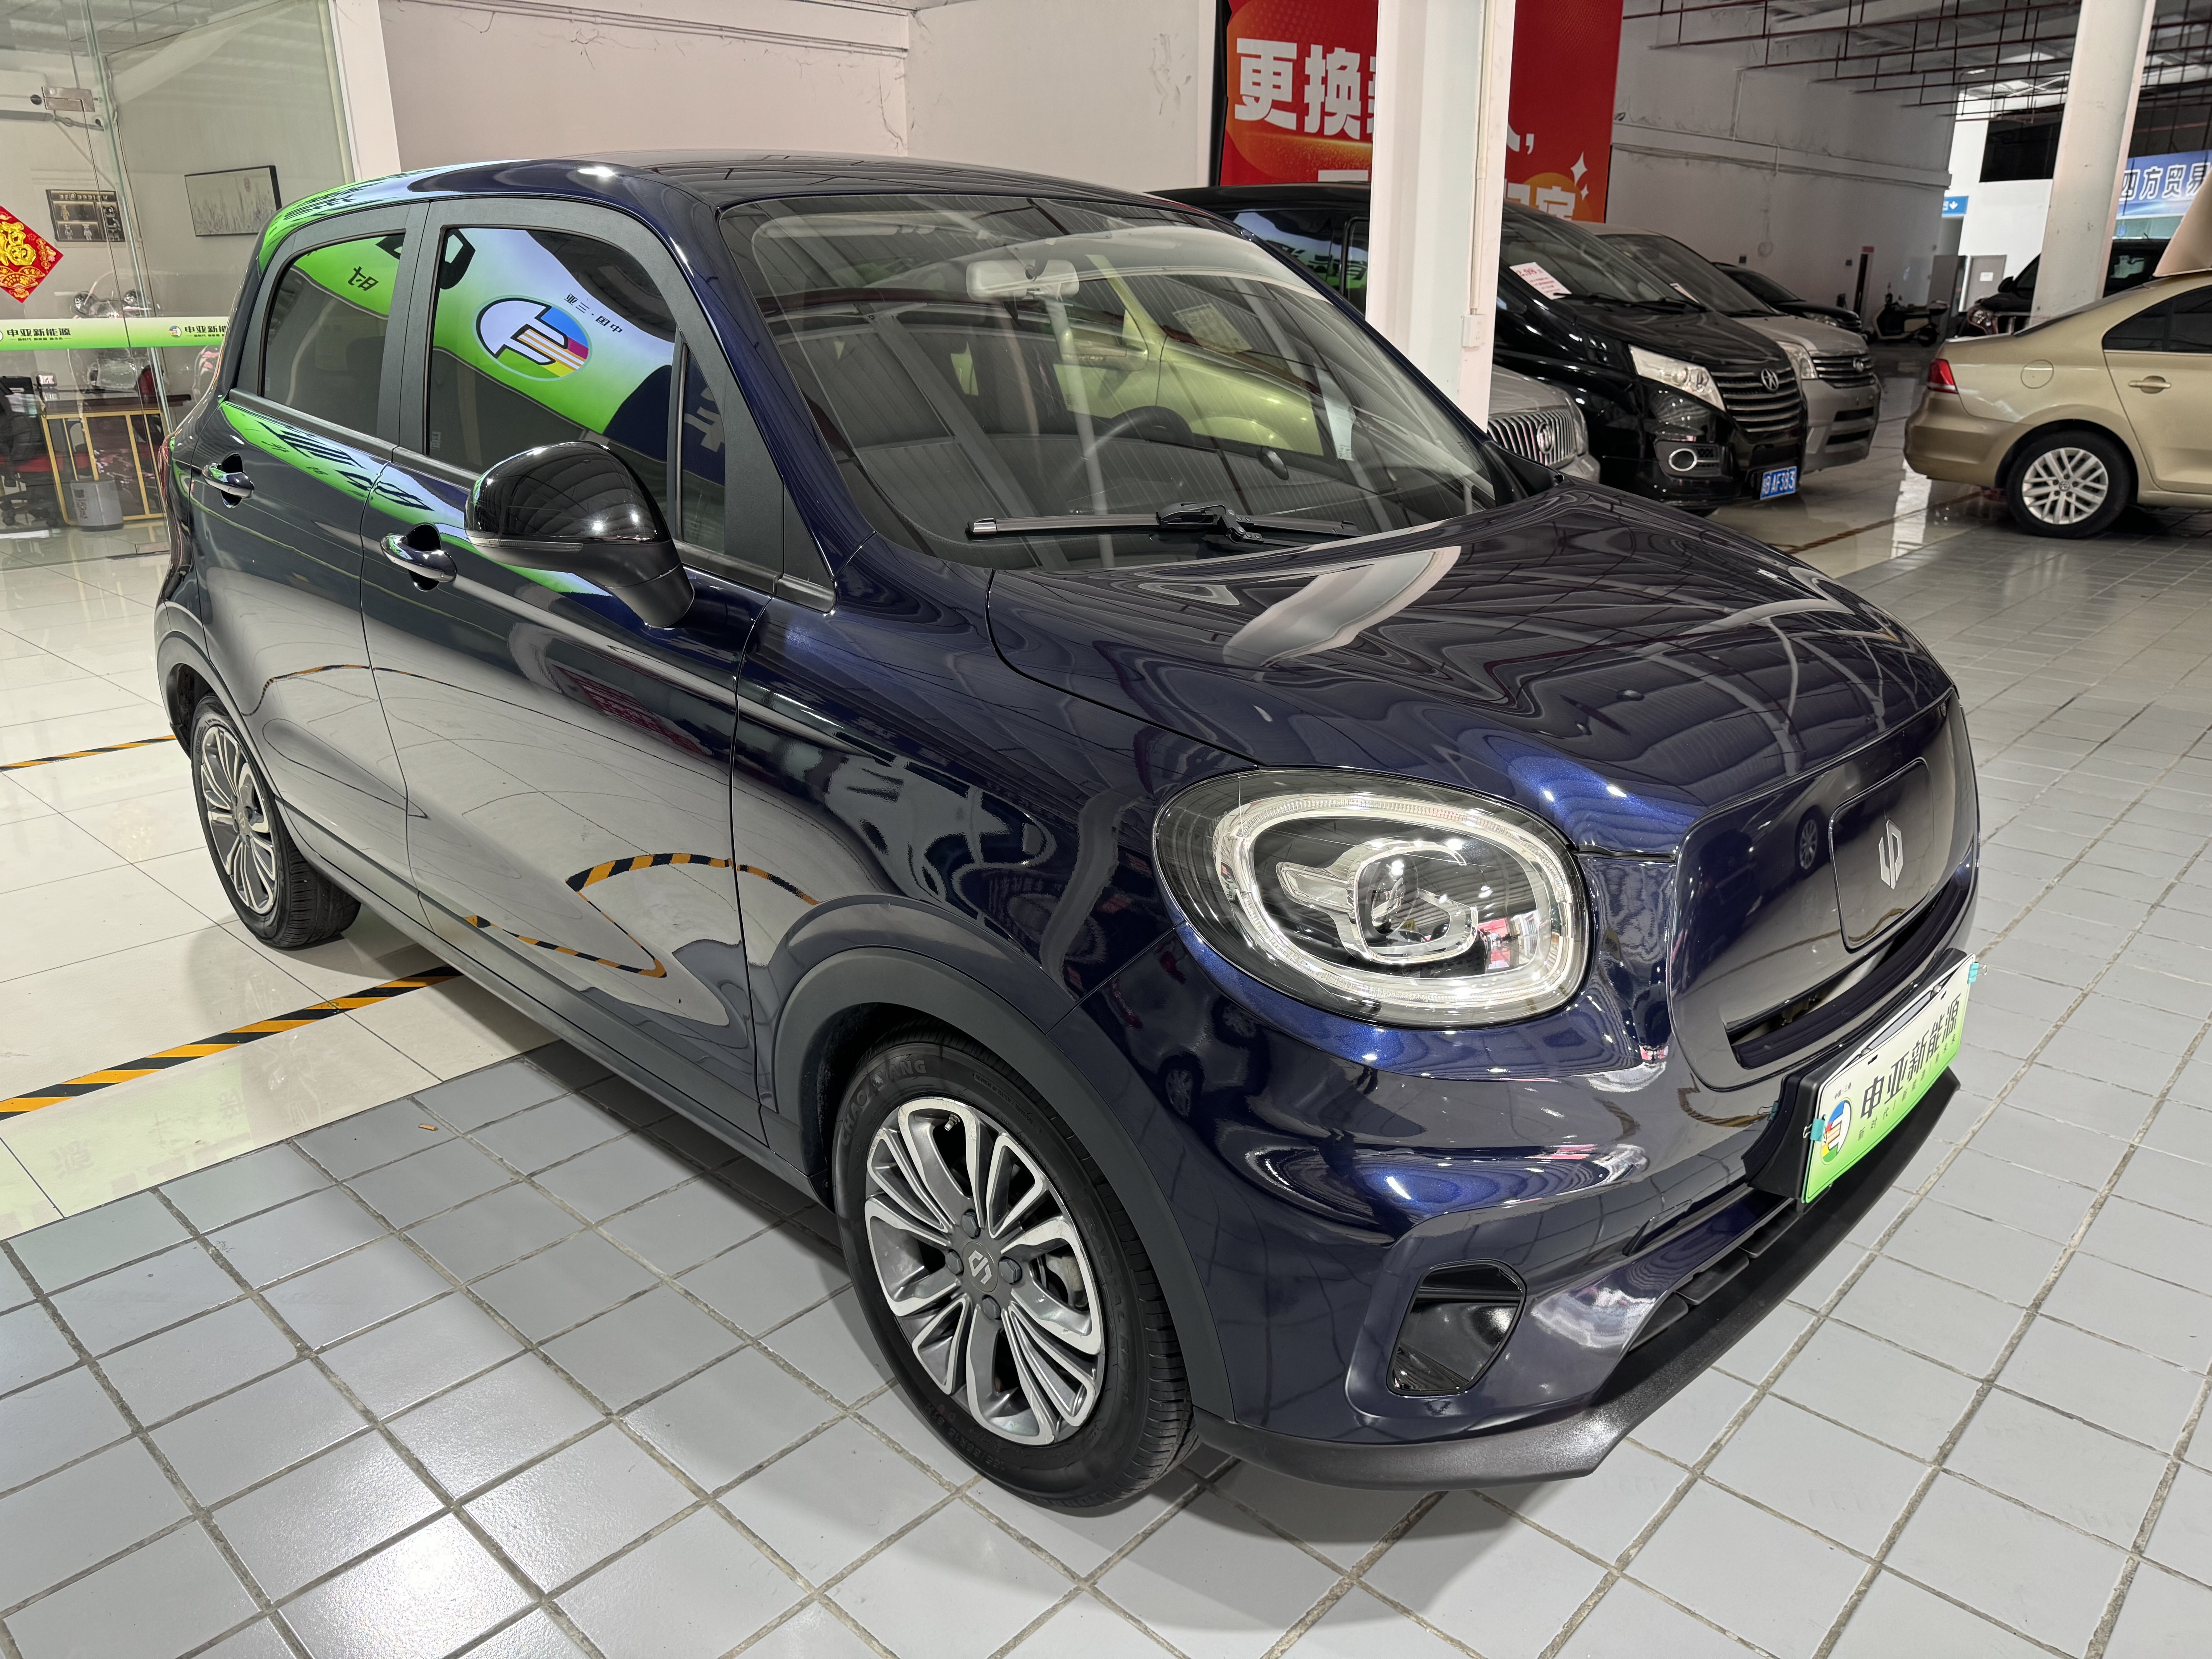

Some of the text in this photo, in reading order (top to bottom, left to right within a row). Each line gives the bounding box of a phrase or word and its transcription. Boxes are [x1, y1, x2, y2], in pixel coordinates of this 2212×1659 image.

[1235, 38, 1376, 140] 更换
[2119, 162, 2211, 201] 四方贸易
[7, 328, 71, 337] 申亚新能源
[1860, 993, 1961, 1119] 申亚新能源
